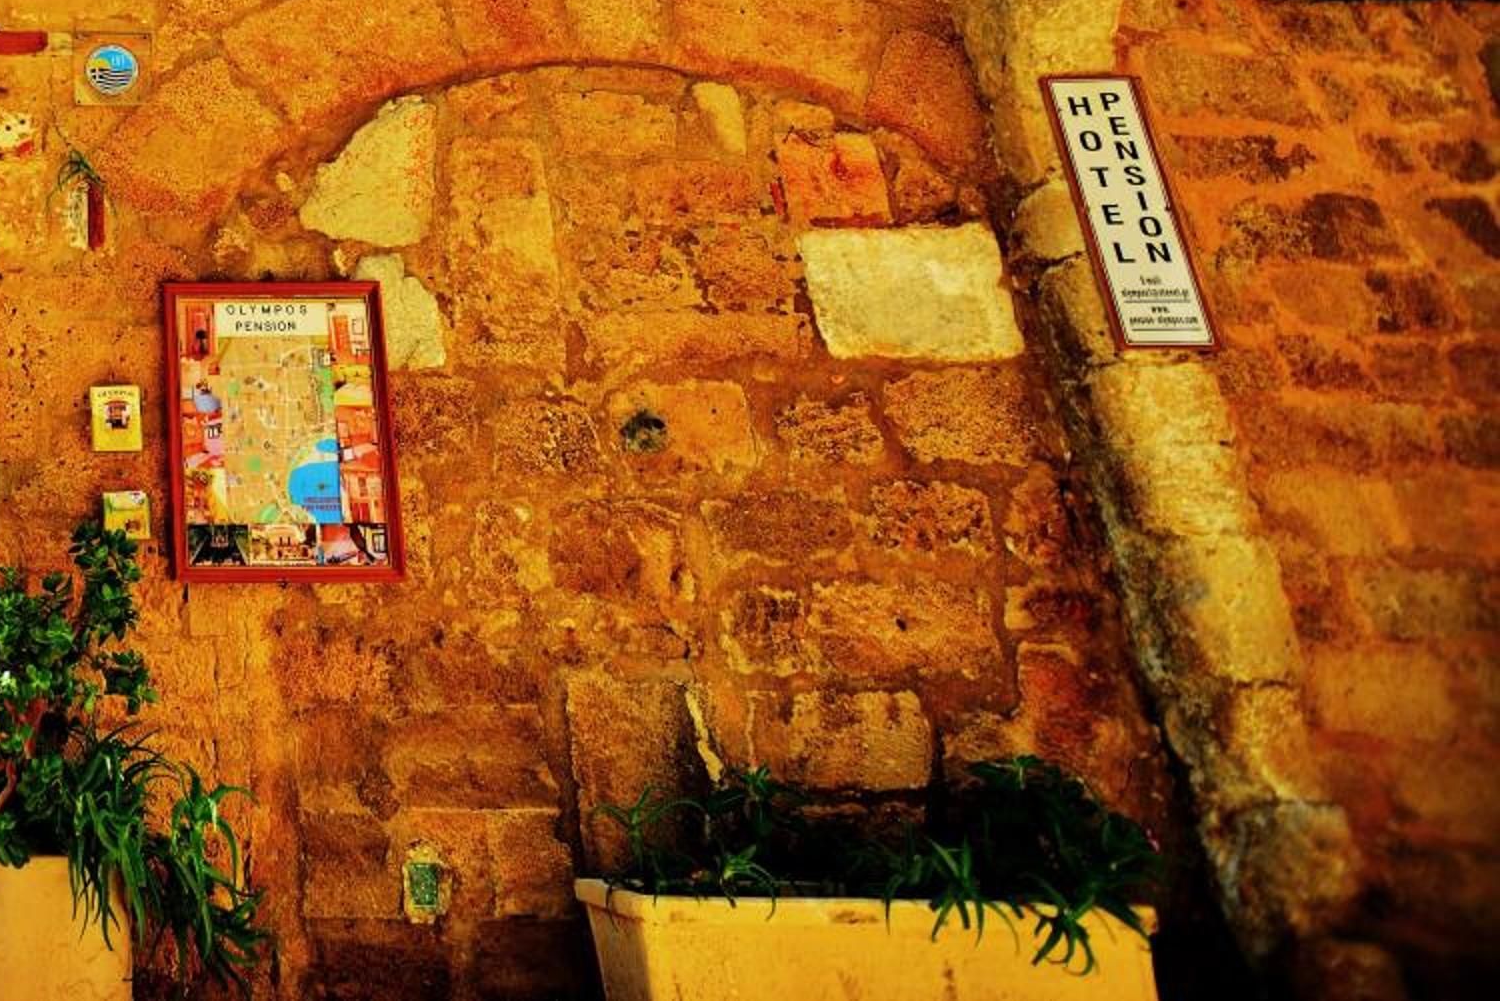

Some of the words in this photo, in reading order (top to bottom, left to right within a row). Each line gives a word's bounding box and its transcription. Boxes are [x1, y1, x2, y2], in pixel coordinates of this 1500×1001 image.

[1066, 95, 1137, 265] HOTEL
[1099, 91, 1173, 264] PENSION
[225, 304, 308, 316] OLYMPOS
[235, 320, 297, 332] PENSION
